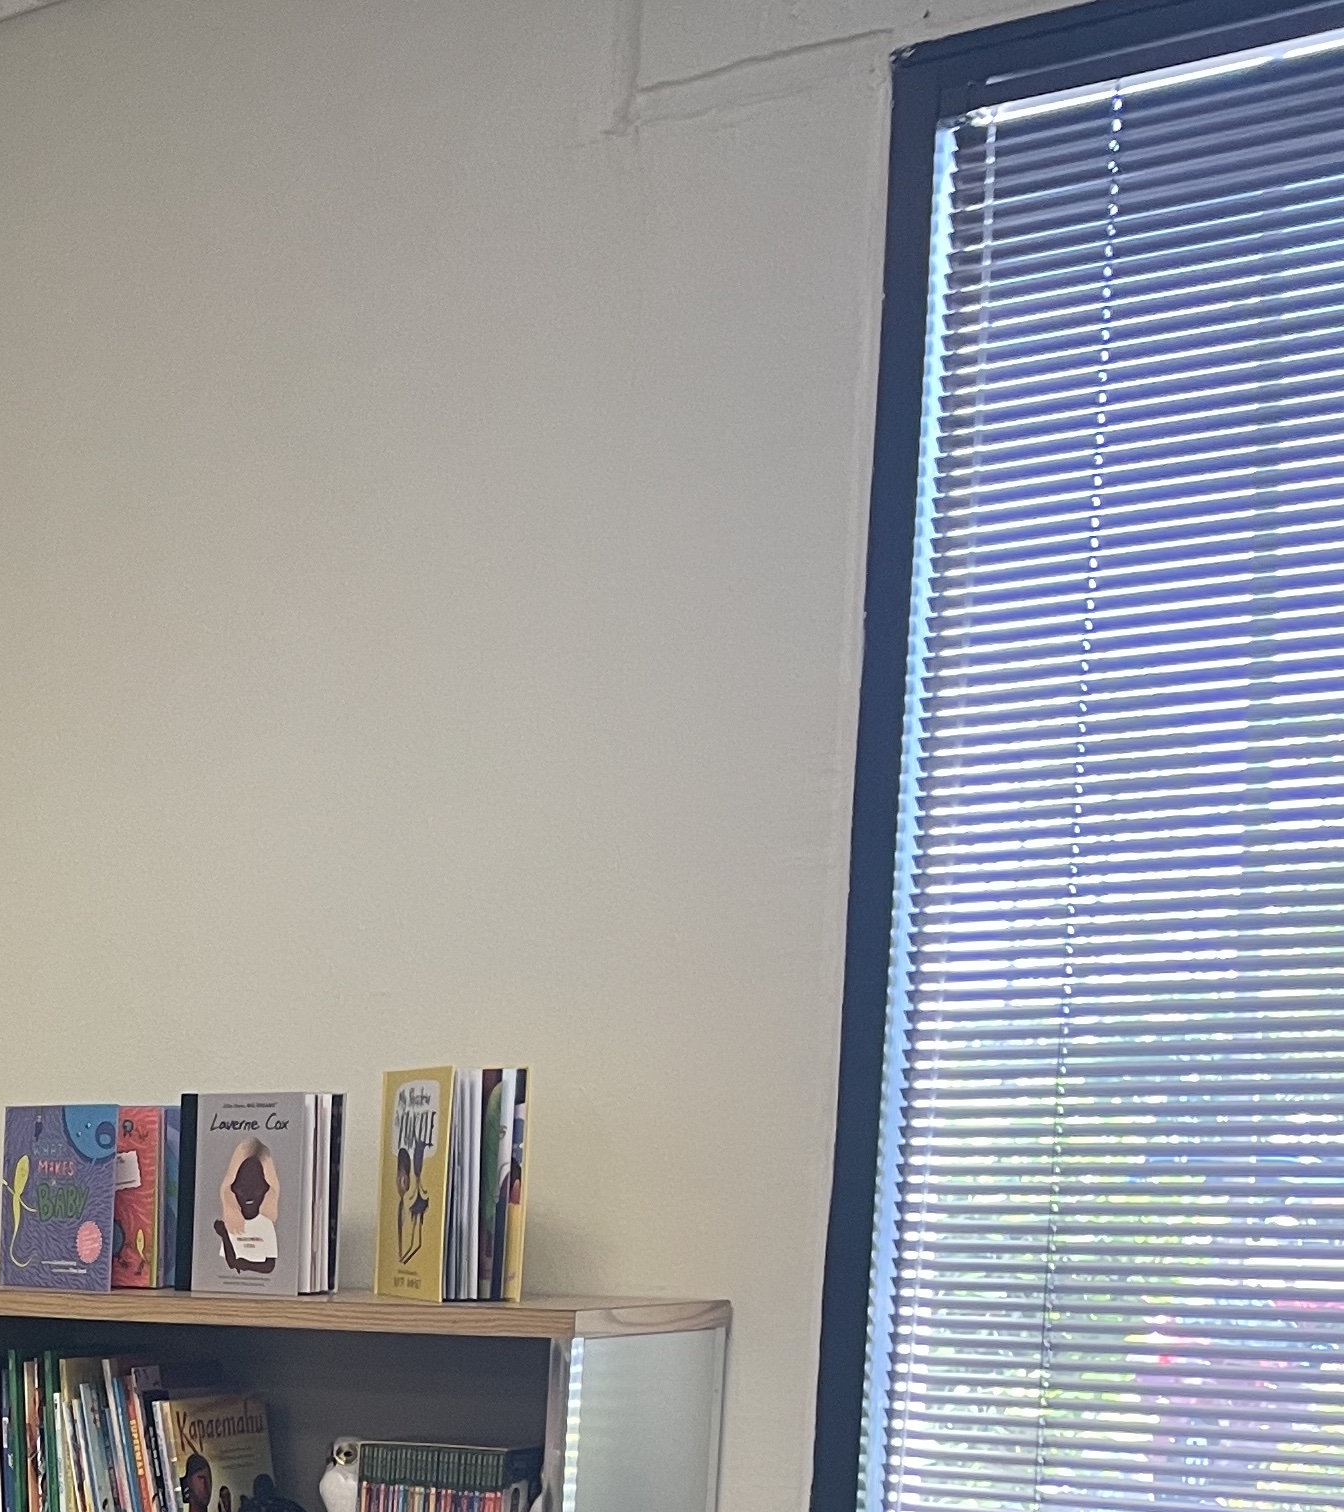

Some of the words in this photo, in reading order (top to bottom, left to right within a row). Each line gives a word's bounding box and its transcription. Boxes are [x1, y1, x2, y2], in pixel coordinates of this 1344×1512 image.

[209, 1112, 262, 1133] Laverne
[265, 1116, 290, 1132] Cox
[37, 1158, 76, 1177] MAKES
[175, 1407, 264, 1454] Kapaemahu
